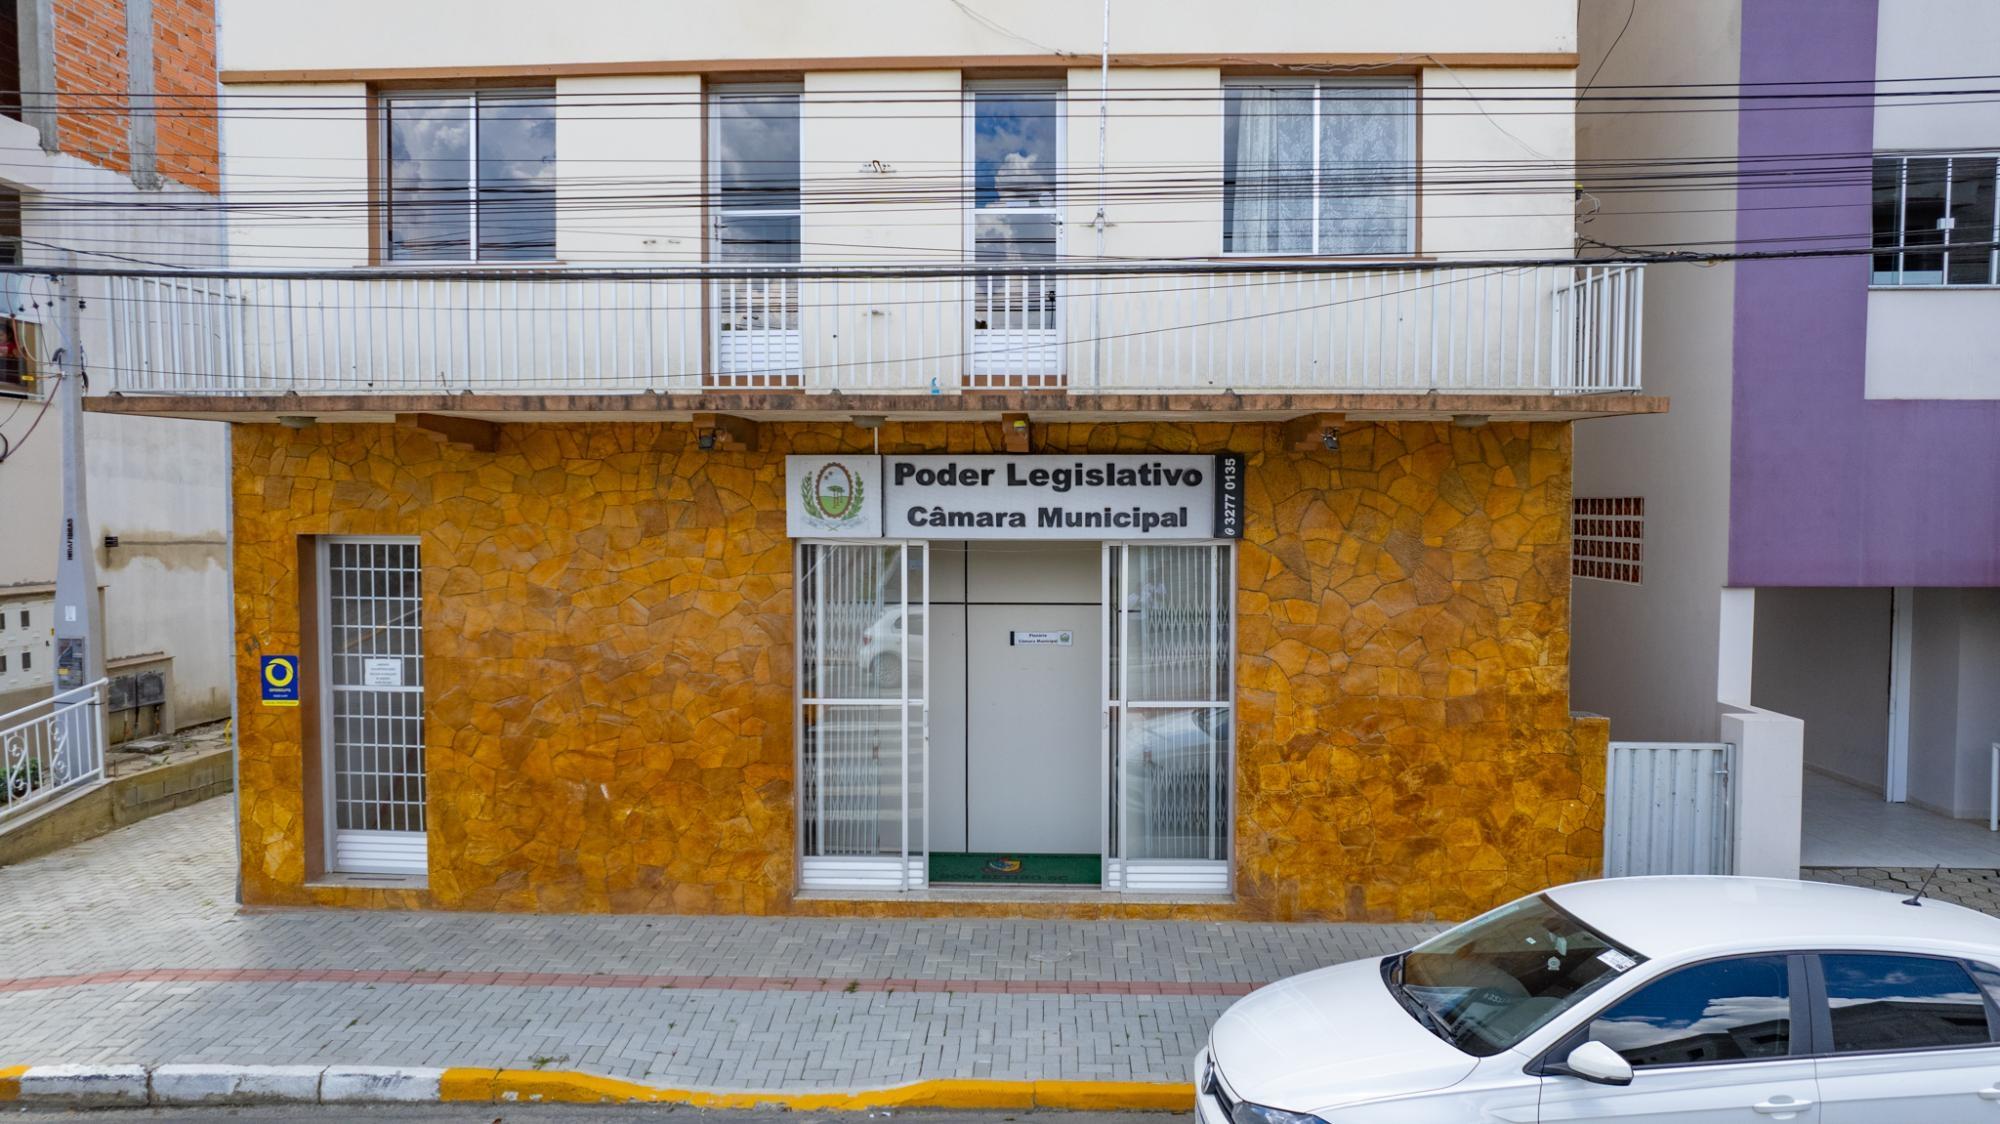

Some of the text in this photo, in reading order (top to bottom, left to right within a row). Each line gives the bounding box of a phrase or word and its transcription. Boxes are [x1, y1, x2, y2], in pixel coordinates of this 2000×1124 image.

[894, 463, 1203, 492] Poder Legislativo
[1224, 458, 1236, 525] 3277 0135
[907, 506, 1187, 533] Câmara Municipal
